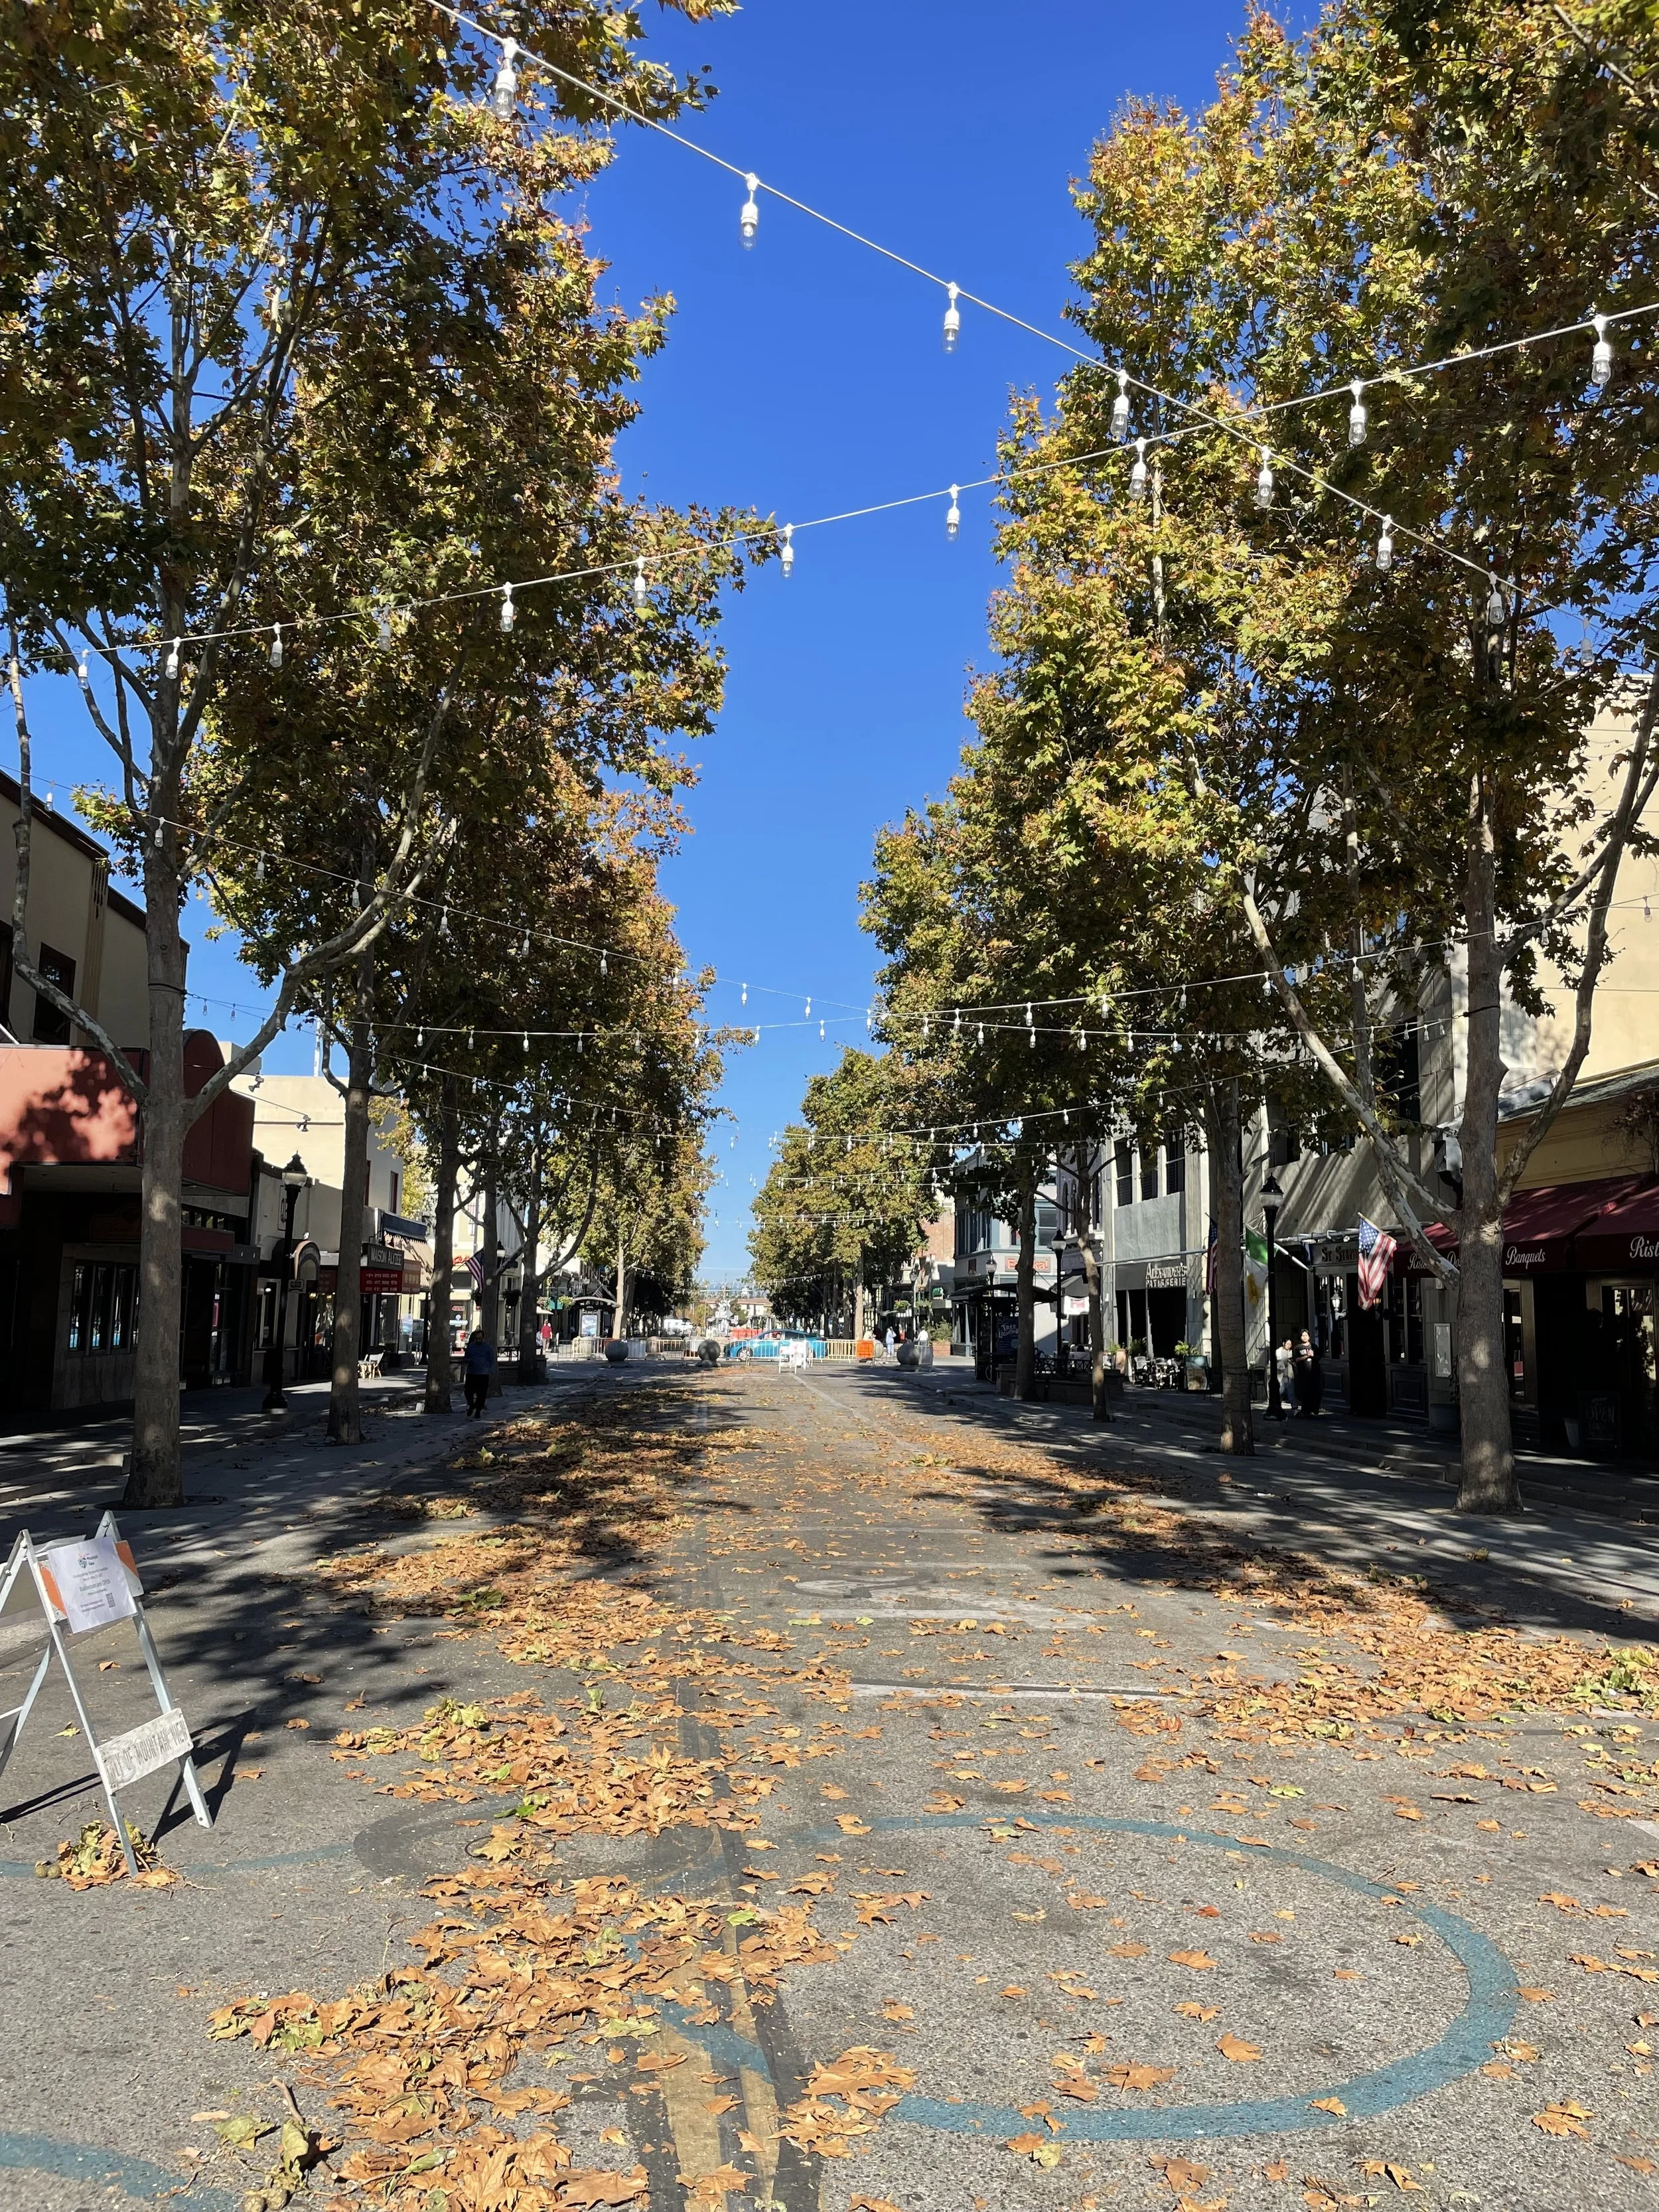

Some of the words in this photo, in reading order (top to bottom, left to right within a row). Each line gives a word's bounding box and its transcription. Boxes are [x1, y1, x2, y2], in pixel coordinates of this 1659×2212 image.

[1630, 1235, 1659, 1258] Rist
[370, 1248, 387, 1264] MAISON
[1007, 1258, 1048, 1270] Eka!
[1505, 1246, 1546, 1270] Banquets
[1145, 1277, 1186, 1288] PATISSERIE
